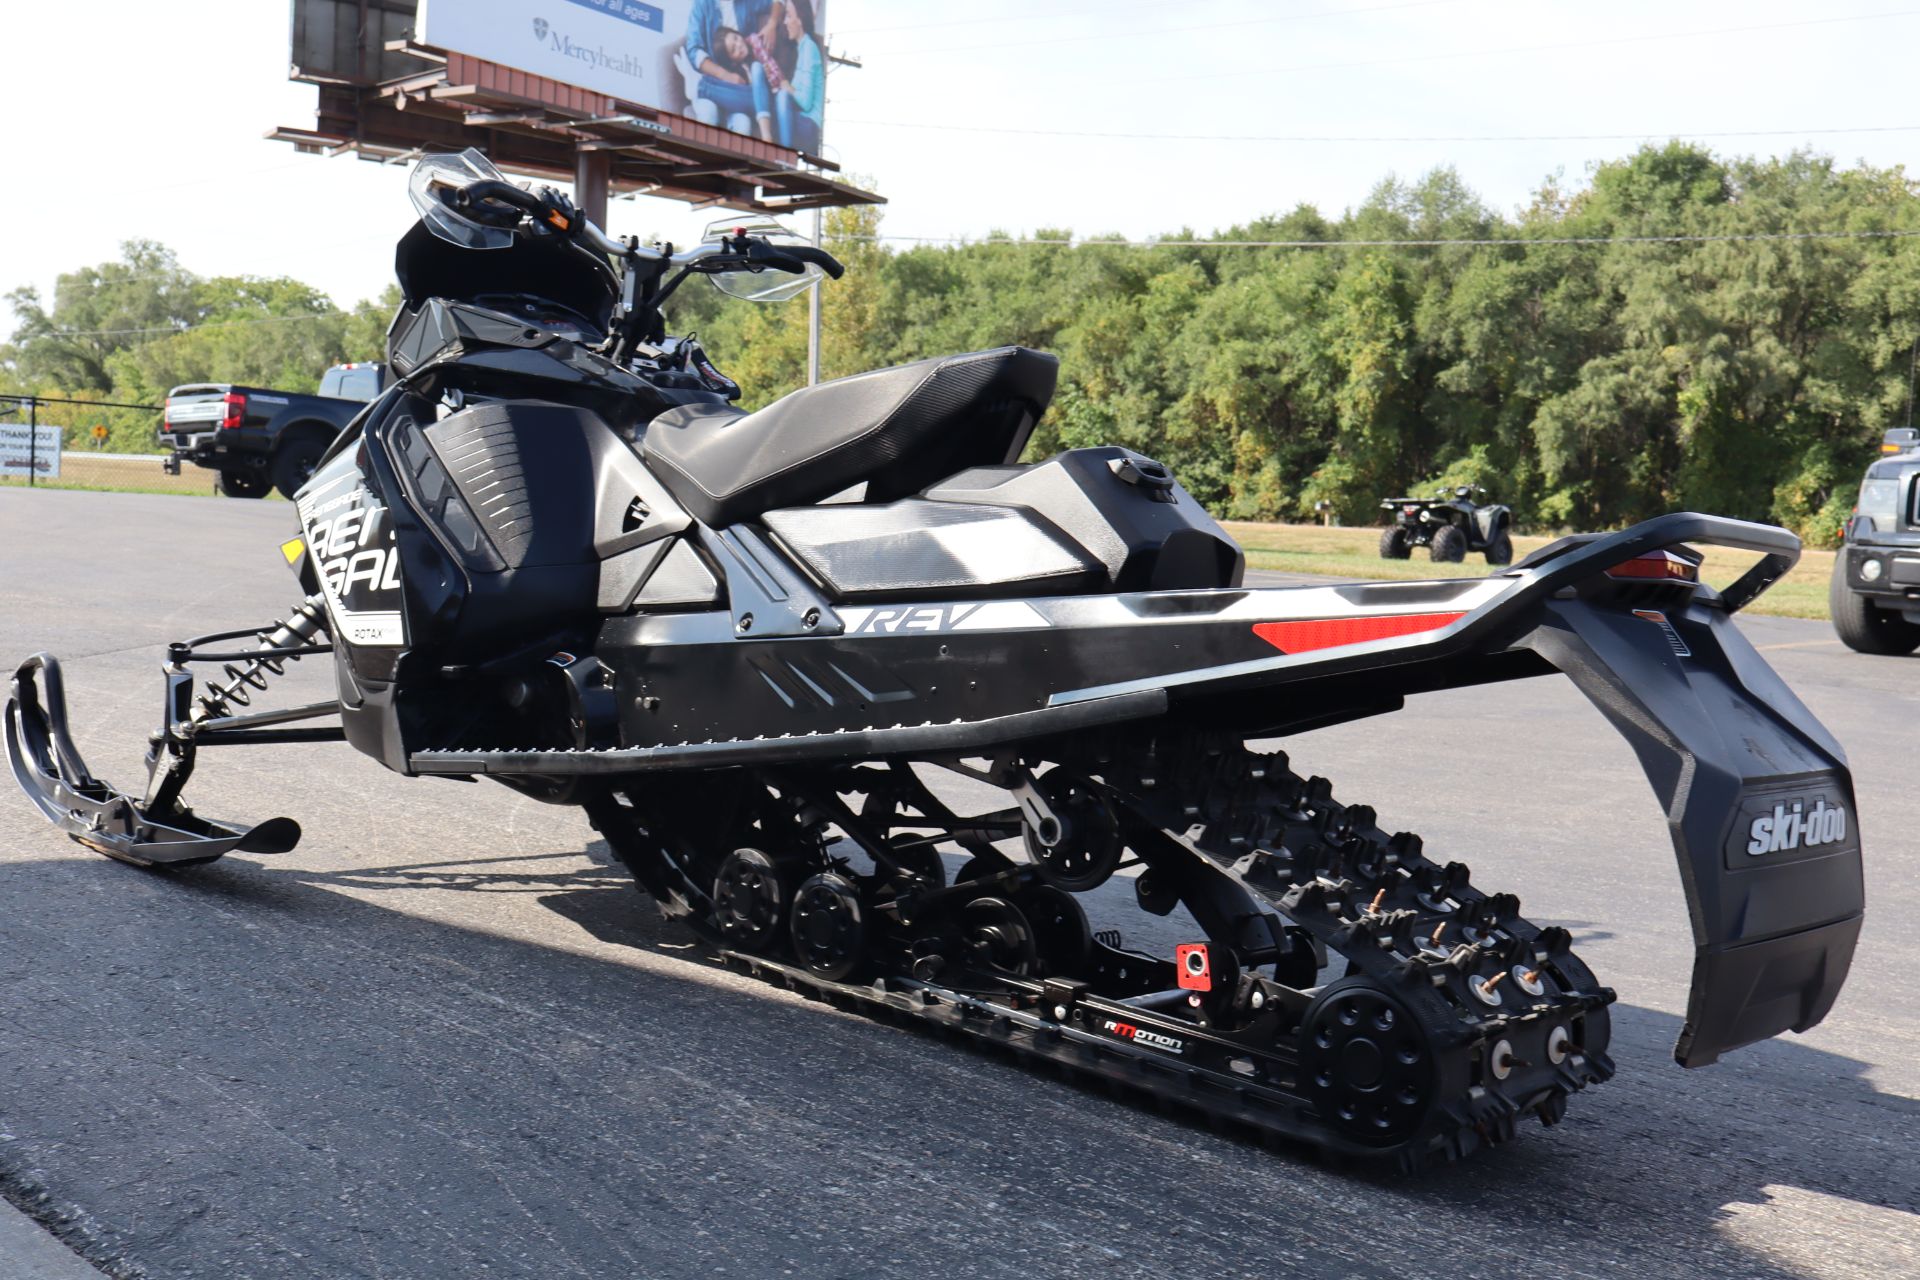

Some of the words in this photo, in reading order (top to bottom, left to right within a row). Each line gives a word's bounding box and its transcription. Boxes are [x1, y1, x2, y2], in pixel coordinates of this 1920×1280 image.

[624, 5, 651, 21] ages
[551, 31, 643, 78] Mercyhealth
[854, 603, 987, 633] REV
[355, 628, 383, 639] ROTAX
[1747, 800, 1846, 856] ski-doo
